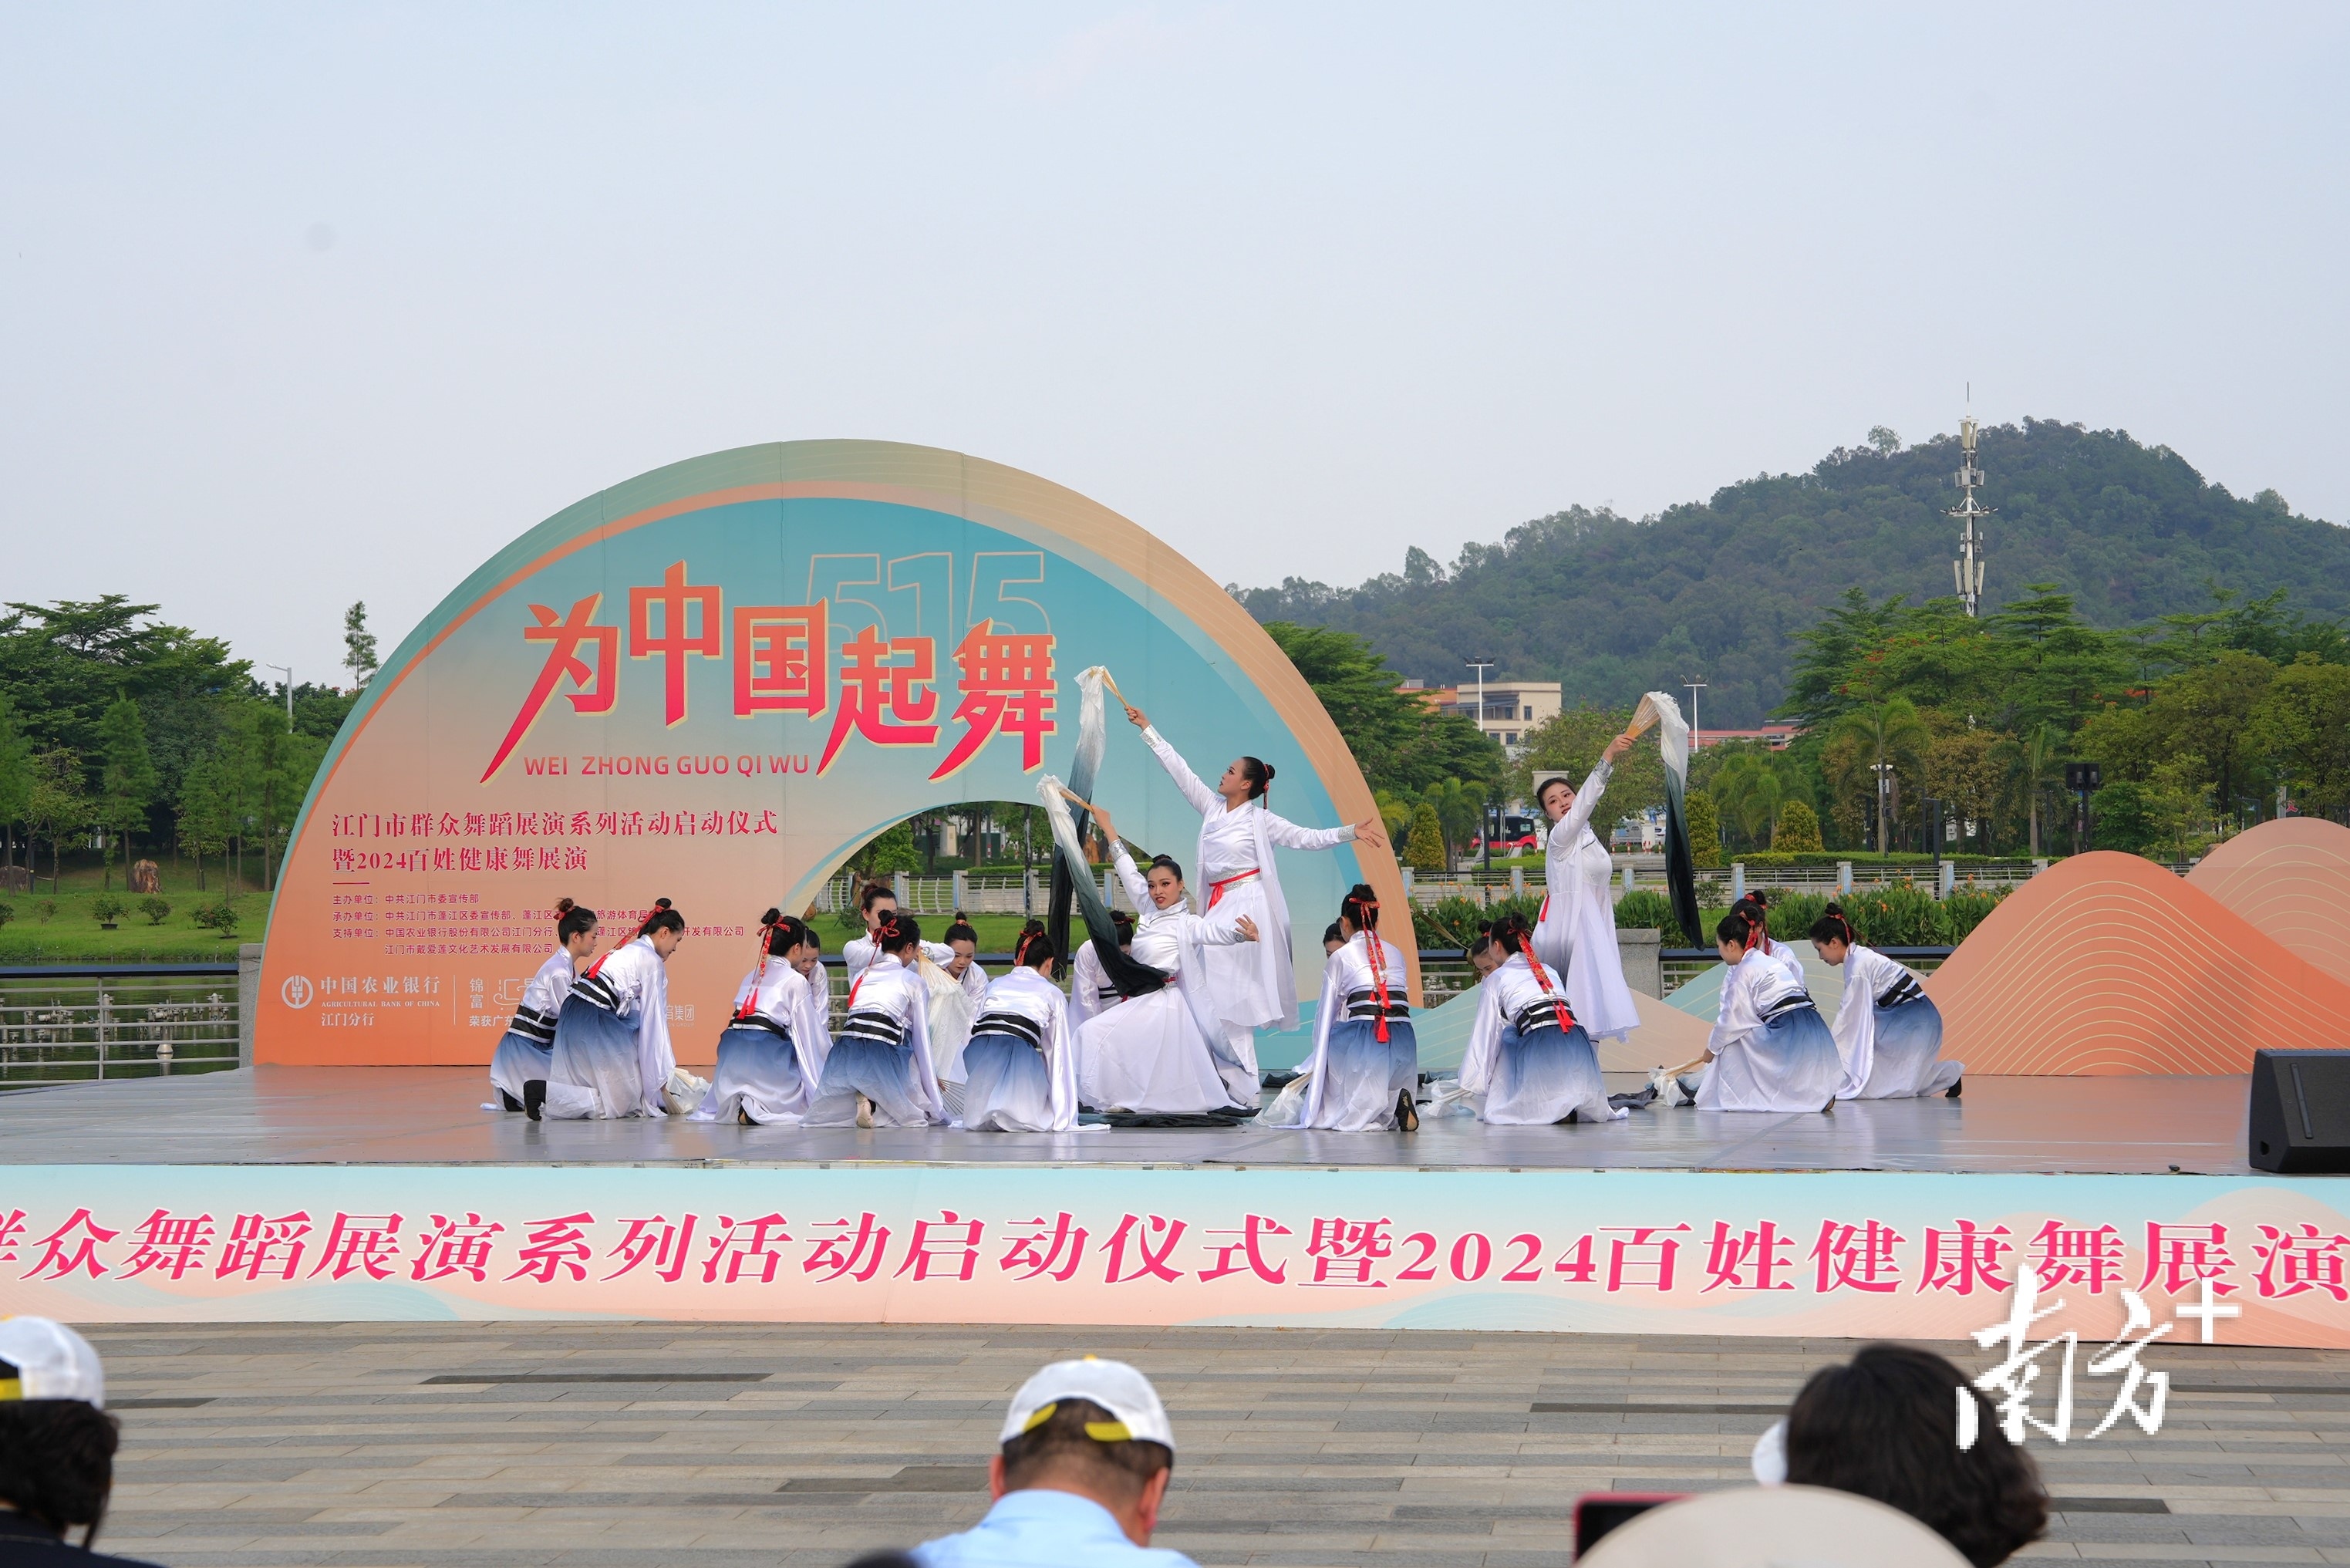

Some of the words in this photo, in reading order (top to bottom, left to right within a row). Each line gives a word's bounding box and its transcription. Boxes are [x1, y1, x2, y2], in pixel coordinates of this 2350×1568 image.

[805, 551, 1050, 679] 515
[480, 559, 1058, 785] 为中国起舞
[524, 756, 568, 775] WEI
[581, 755, 669, 775] ZHONG
[676, 755, 730, 774] GUO
[737, 755, 762, 777] QI
[768, 754, 809, 774] WU
[332, 810, 778, 838] 江门市群众舞蹈展演系列活动启动仪式
[332, 845, 588, 872] 暨2024百姓健康舞展演
[385, 944, 553, 955] 江门市戴爱莲文化艺术发展有限公司
[321, 976, 440, 995] 中国农业银行
[470, 978, 484, 1009] 锦富
[321, 1013, 375, 1027] 江门分行
